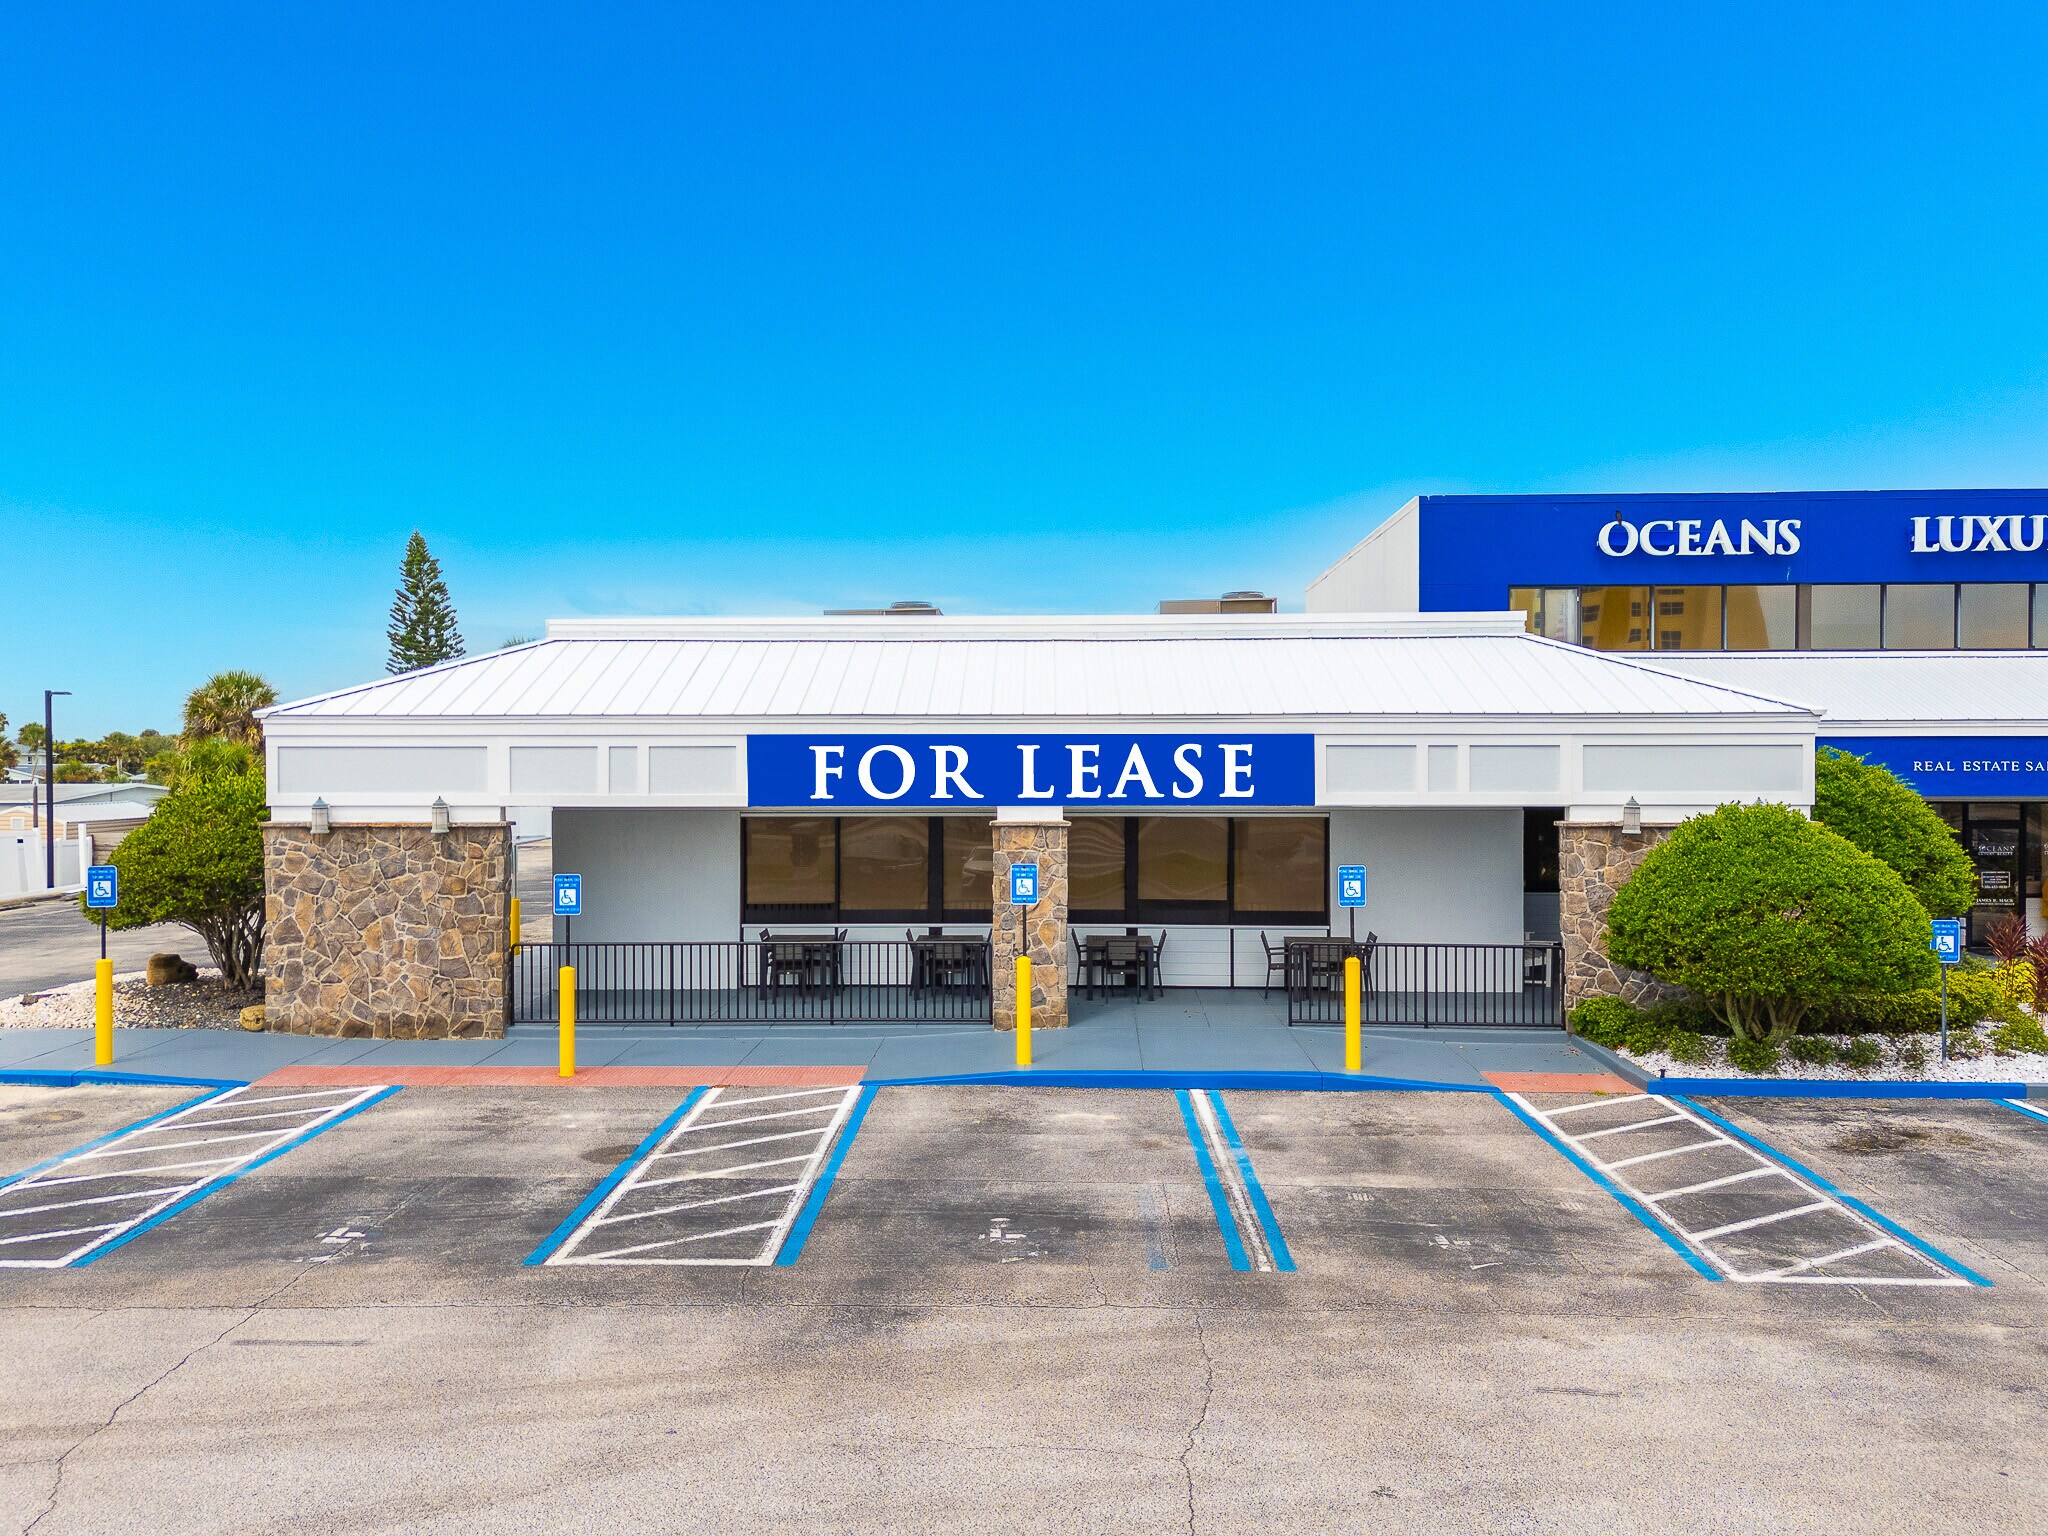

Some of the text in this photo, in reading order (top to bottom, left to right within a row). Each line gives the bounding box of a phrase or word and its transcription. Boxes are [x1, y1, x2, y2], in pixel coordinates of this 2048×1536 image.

[1598, 514, 2048, 557] OCEANS LUXU
[809, 743, 1256, 799] FOR LEASE
[1913, 760, 1955, 772] REAL
[1962, 760, 2020, 772] ESTATE
